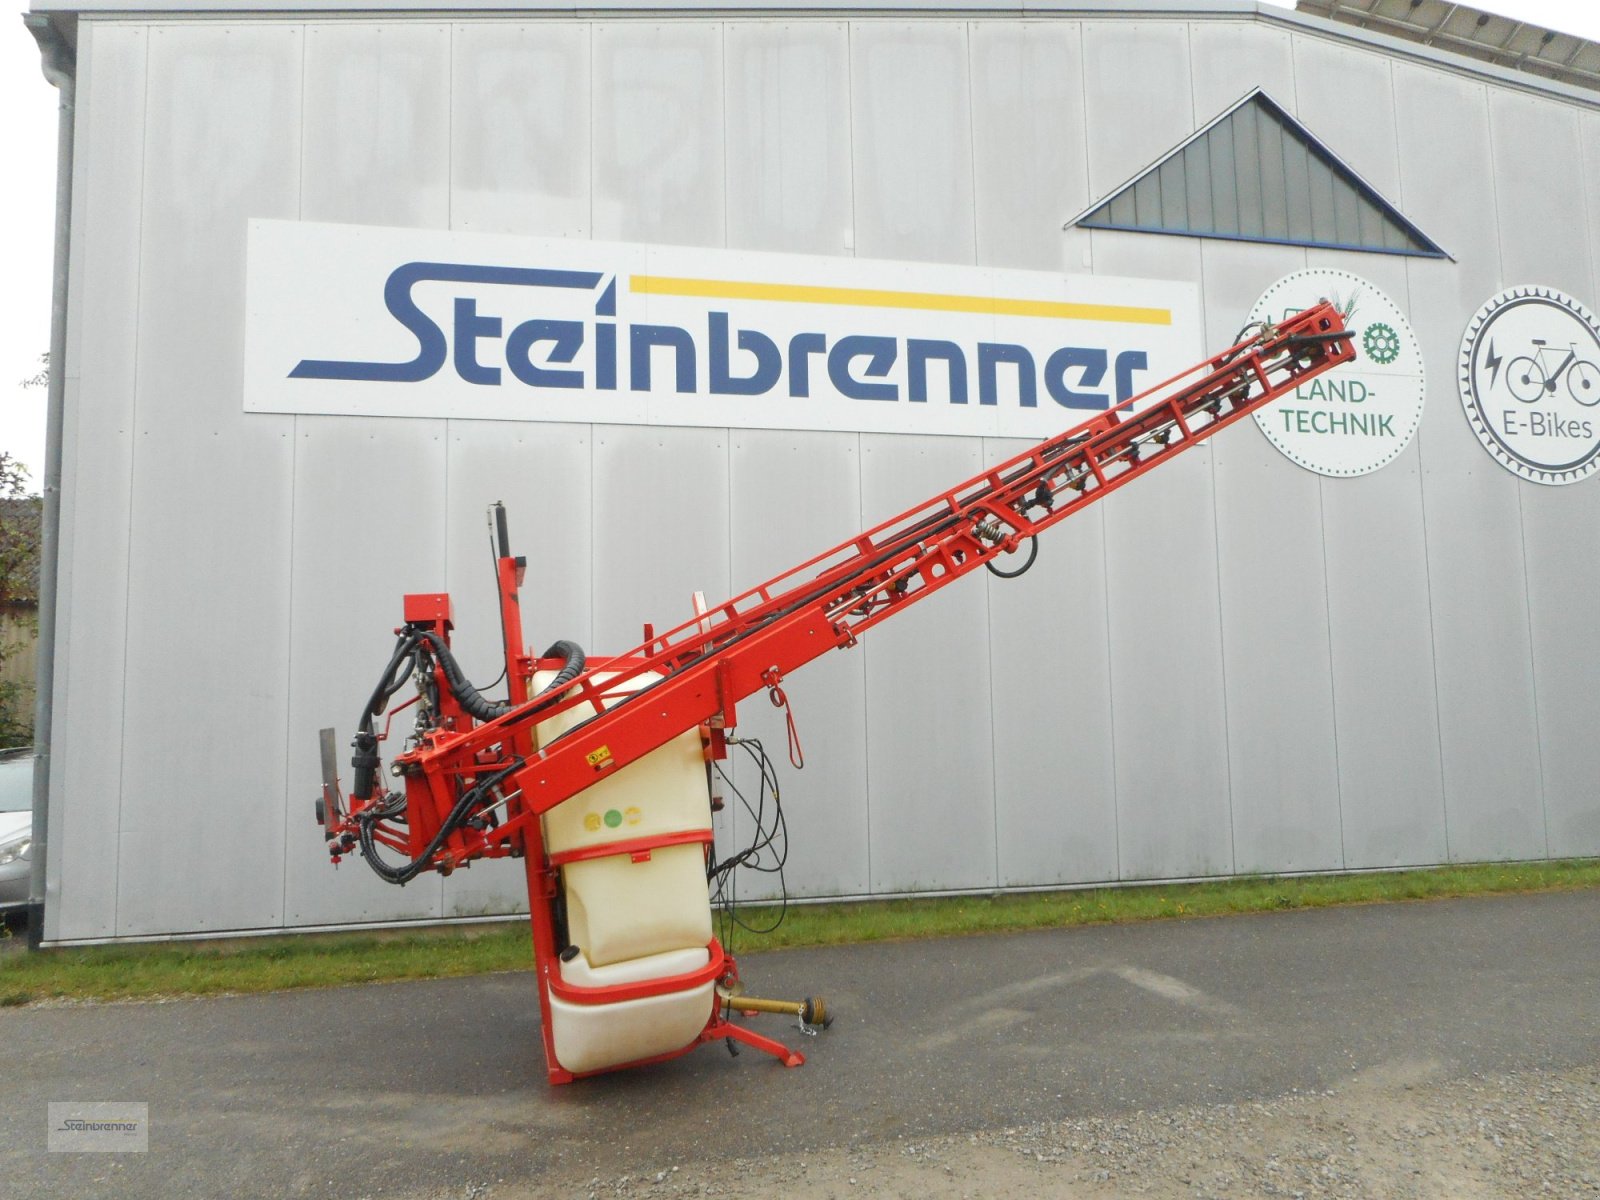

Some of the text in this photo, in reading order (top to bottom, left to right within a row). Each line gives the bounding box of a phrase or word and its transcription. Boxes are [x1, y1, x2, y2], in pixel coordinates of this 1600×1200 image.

[286, 261, 1148, 412] Steinbrenner
[1296, 379, 1376, 403] LAND-
[1278, 409, 1396, 437] TECHNIK
[1503, 410, 1593, 439] E-Bikes
